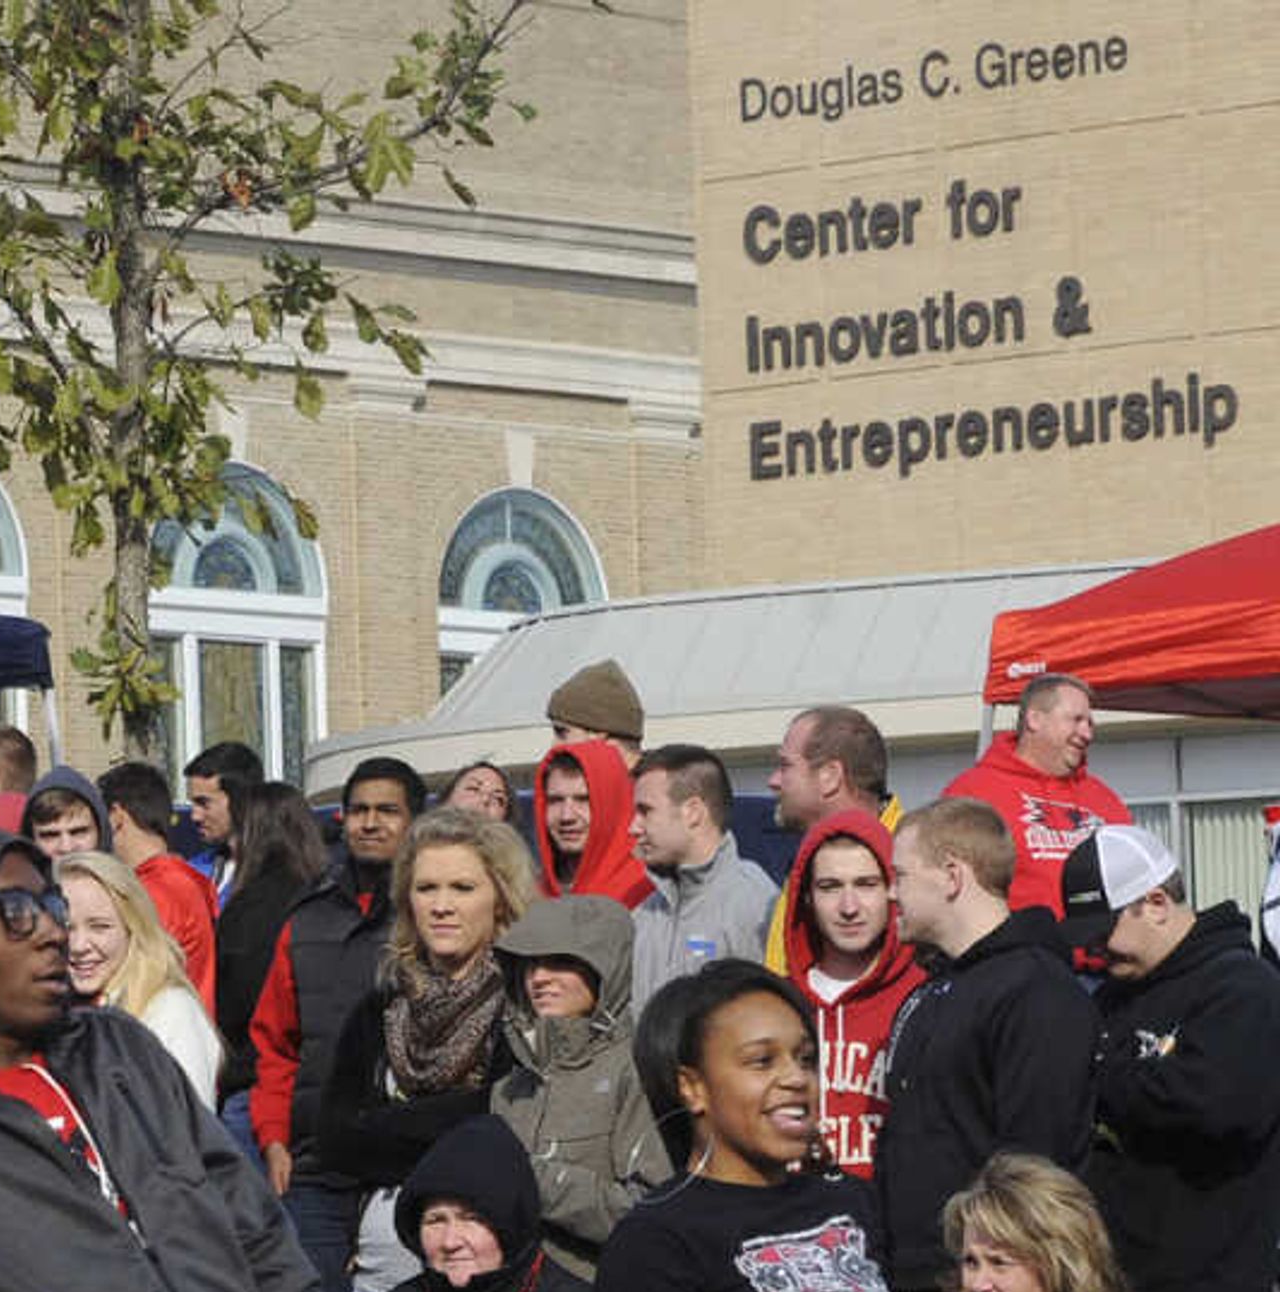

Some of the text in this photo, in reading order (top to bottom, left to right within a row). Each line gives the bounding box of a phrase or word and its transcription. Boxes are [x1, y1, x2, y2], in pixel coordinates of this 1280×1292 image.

[740, 35, 1128, 123] Douglas C. Greene
[743, 179, 1022, 265] Center for
[746, 276, 1093, 374] Innovation &
[749, 373, 1239, 481] Entrepreneurship
